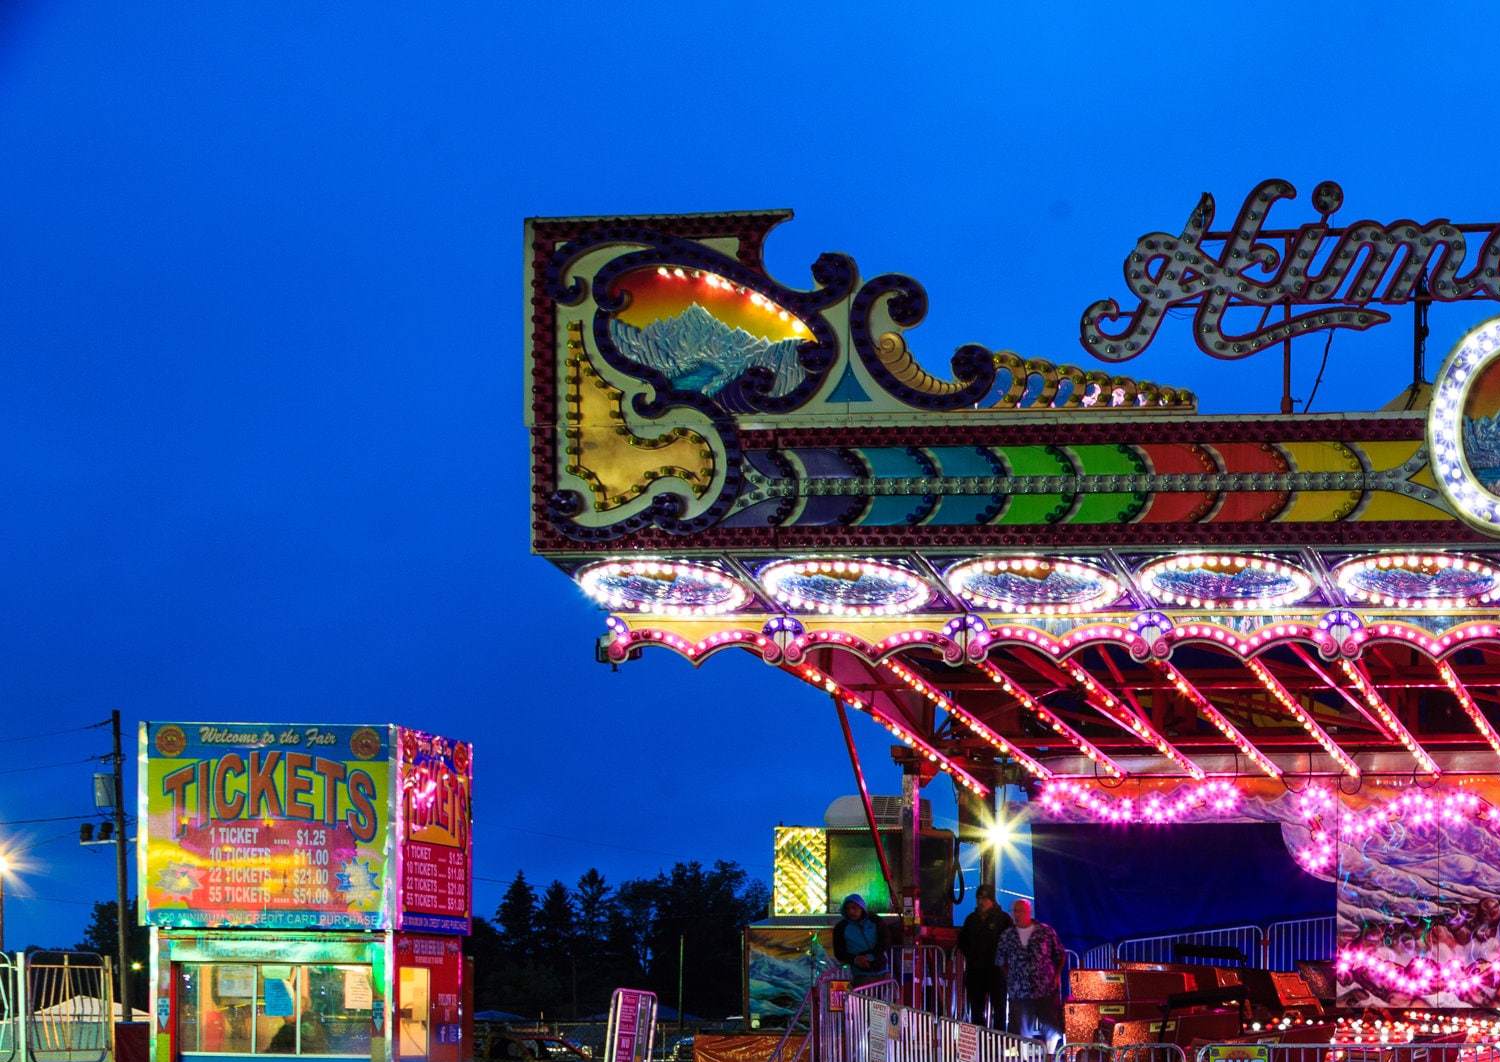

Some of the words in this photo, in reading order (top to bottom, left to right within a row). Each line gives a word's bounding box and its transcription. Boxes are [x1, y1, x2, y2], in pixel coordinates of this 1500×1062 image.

[200, 726, 259, 744] Welcome
[262, 730, 276, 744] to
[279, 730, 300, 745] the
[305, 728, 337, 748] Fair
[163, 751, 377, 844] TICKETS
[209, 829, 216, 844] 1
[219, 828, 259, 845] TICKET
[296, 829, 326, 846] $1.25
[209, 847, 222, 862] 10
[224, 847, 271, 864] TICKETS
[293, 849, 328, 866] $11.00
[411, 845, 431, 860] TICKET
[209, 868, 222, 883] 22
[224, 868, 271, 884] TICKETS
[293, 868, 328, 886] $21.00
[414, 861, 438, 877] TICKETS
[414, 877, 438, 893] TICKETS
[209, 887, 222, 902] 55
[224, 887, 271, 904] TICKETS
[293, 887, 328, 905] $51.00
[414, 893, 438, 909] TICKETS
[157, 912, 175, 923] $20
[178, 912, 224, 923] MINIMUM
[229, 914, 243, 923] ON
[245, 914, 284, 924] CREDIT
[287, 914, 317, 925] CARD
[320, 915, 378, 926] PURCHASE
